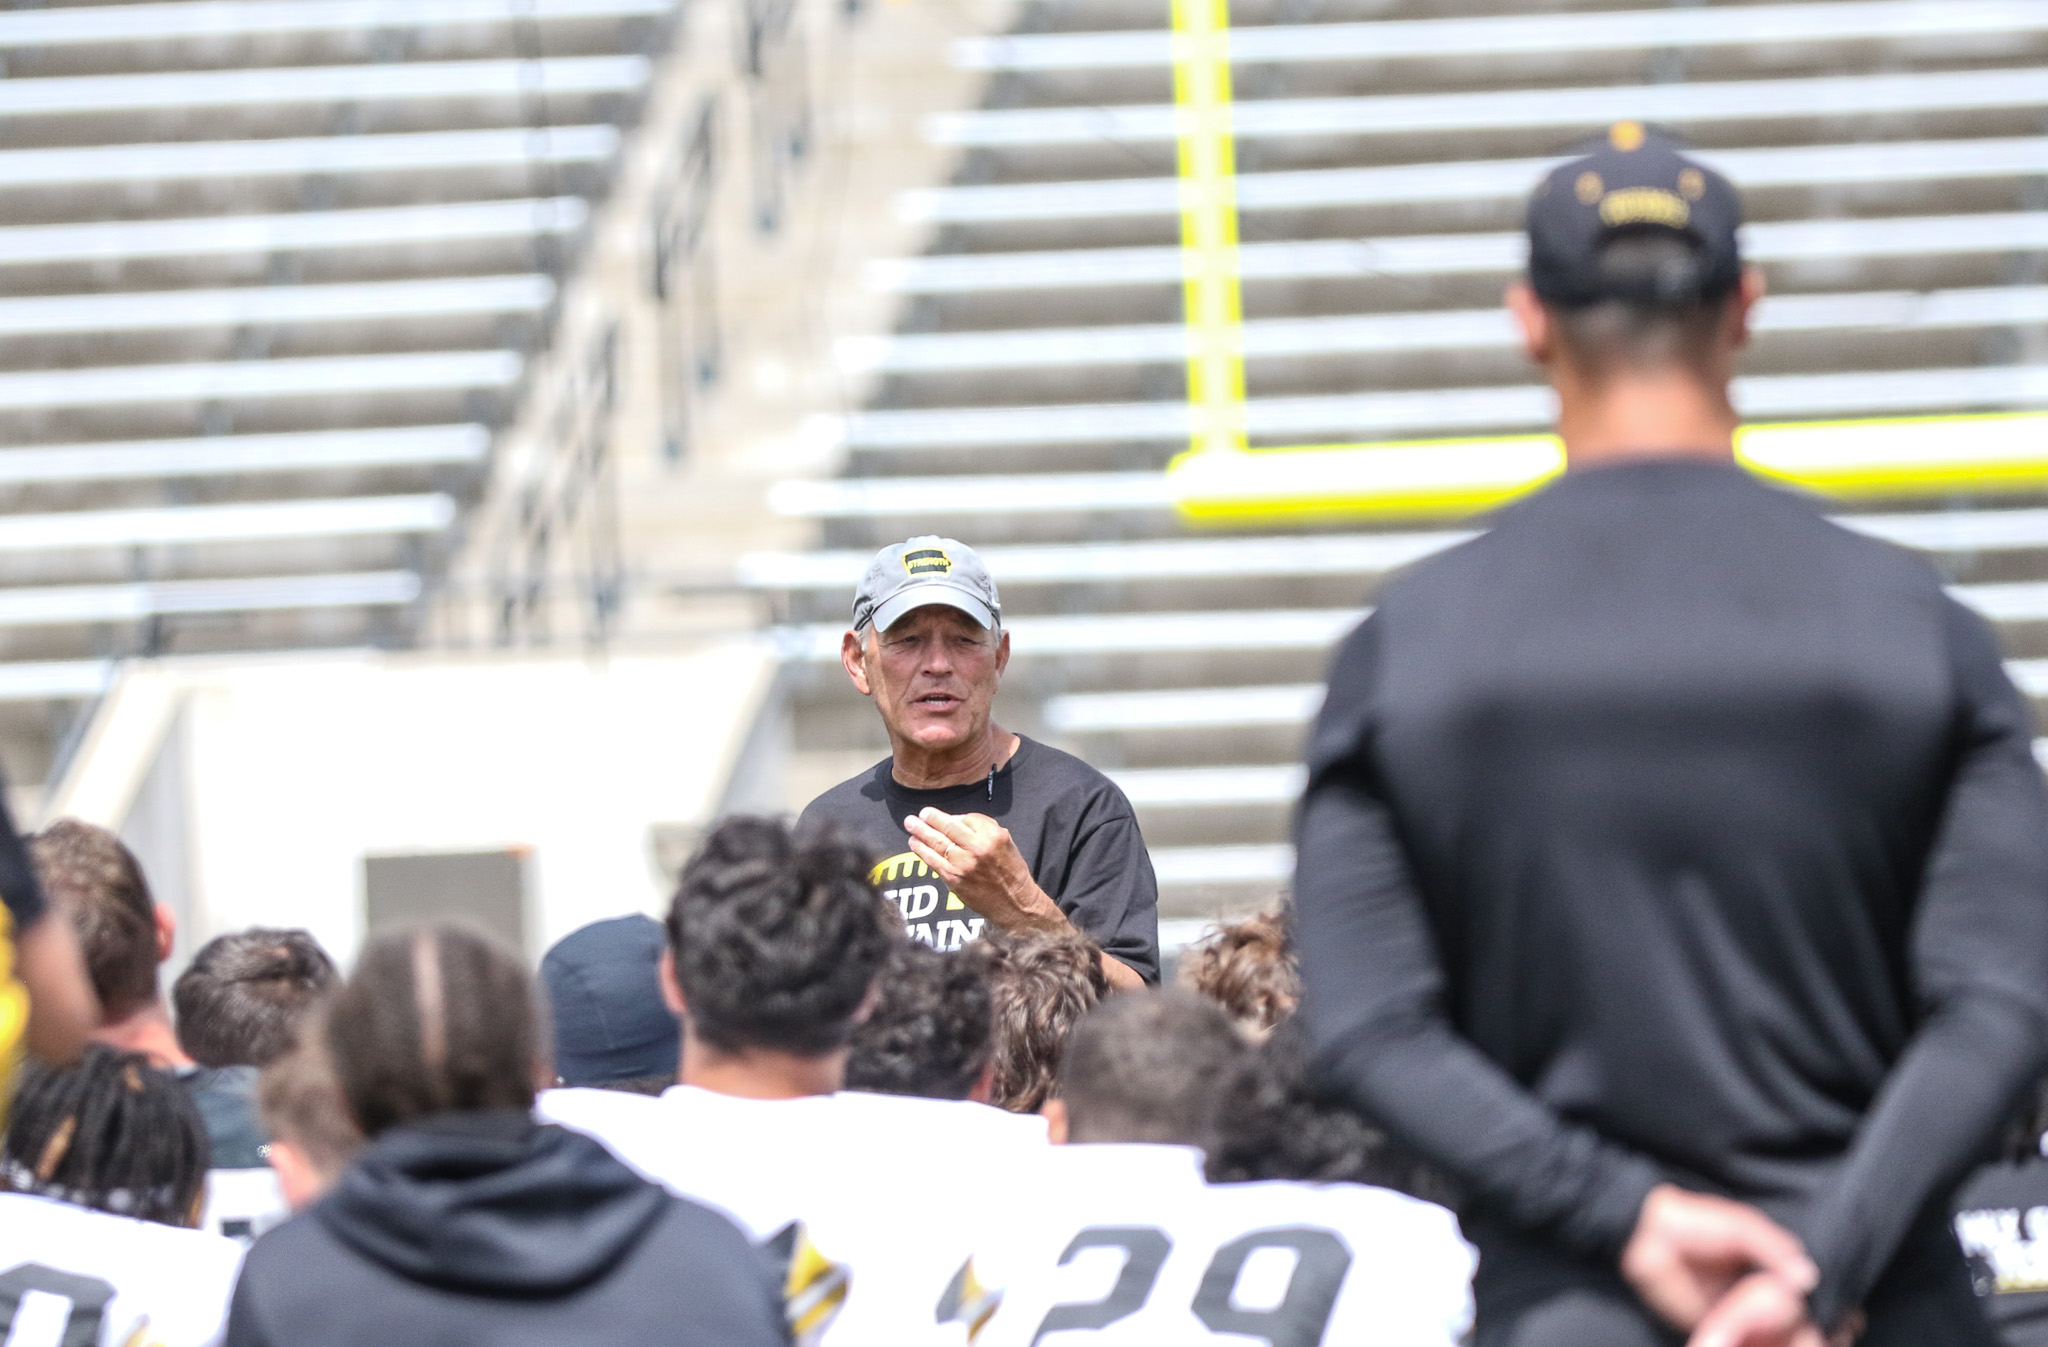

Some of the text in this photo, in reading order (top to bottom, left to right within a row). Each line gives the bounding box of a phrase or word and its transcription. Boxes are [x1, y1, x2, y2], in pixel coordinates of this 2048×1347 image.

[907, 556, 949, 569] STRENGTH
[883, 884, 938, 920] ID
[906, 918, 985, 953] AIN
[1029, 1222, 1354, 1347] 29
